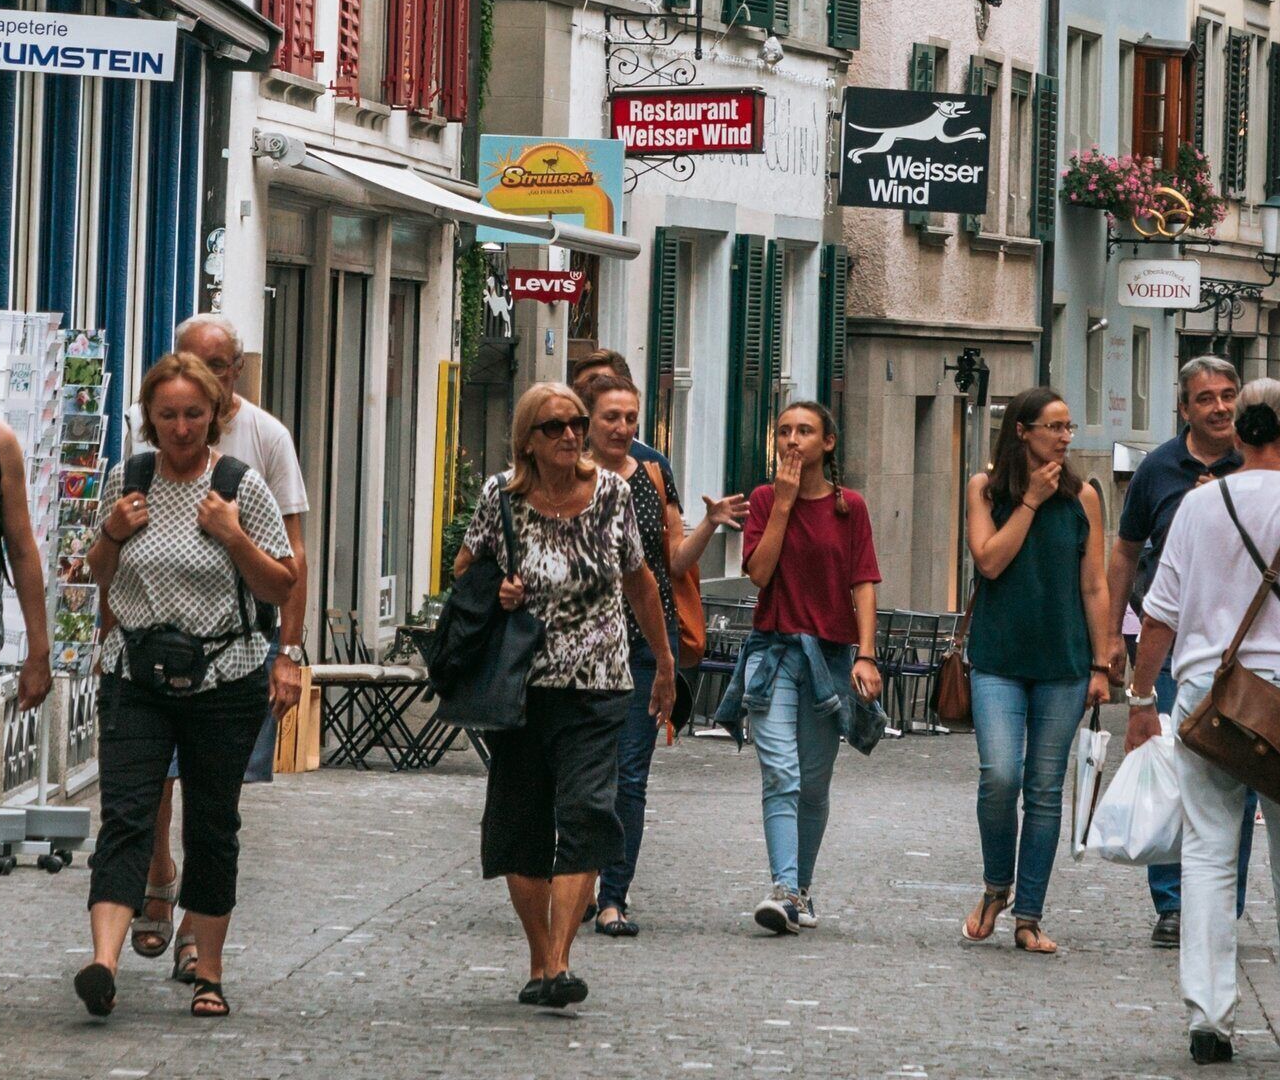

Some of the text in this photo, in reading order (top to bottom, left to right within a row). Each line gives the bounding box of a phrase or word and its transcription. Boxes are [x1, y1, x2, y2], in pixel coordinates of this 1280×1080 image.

[629, 99, 739, 122] Restaurant
[616, 123, 752, 147] Weisser Wind
[886, 154, 984, 184] Weisser
[868, 178, 930, 205] Wind
[1127, 283, 1191, 298] VOHDIN
